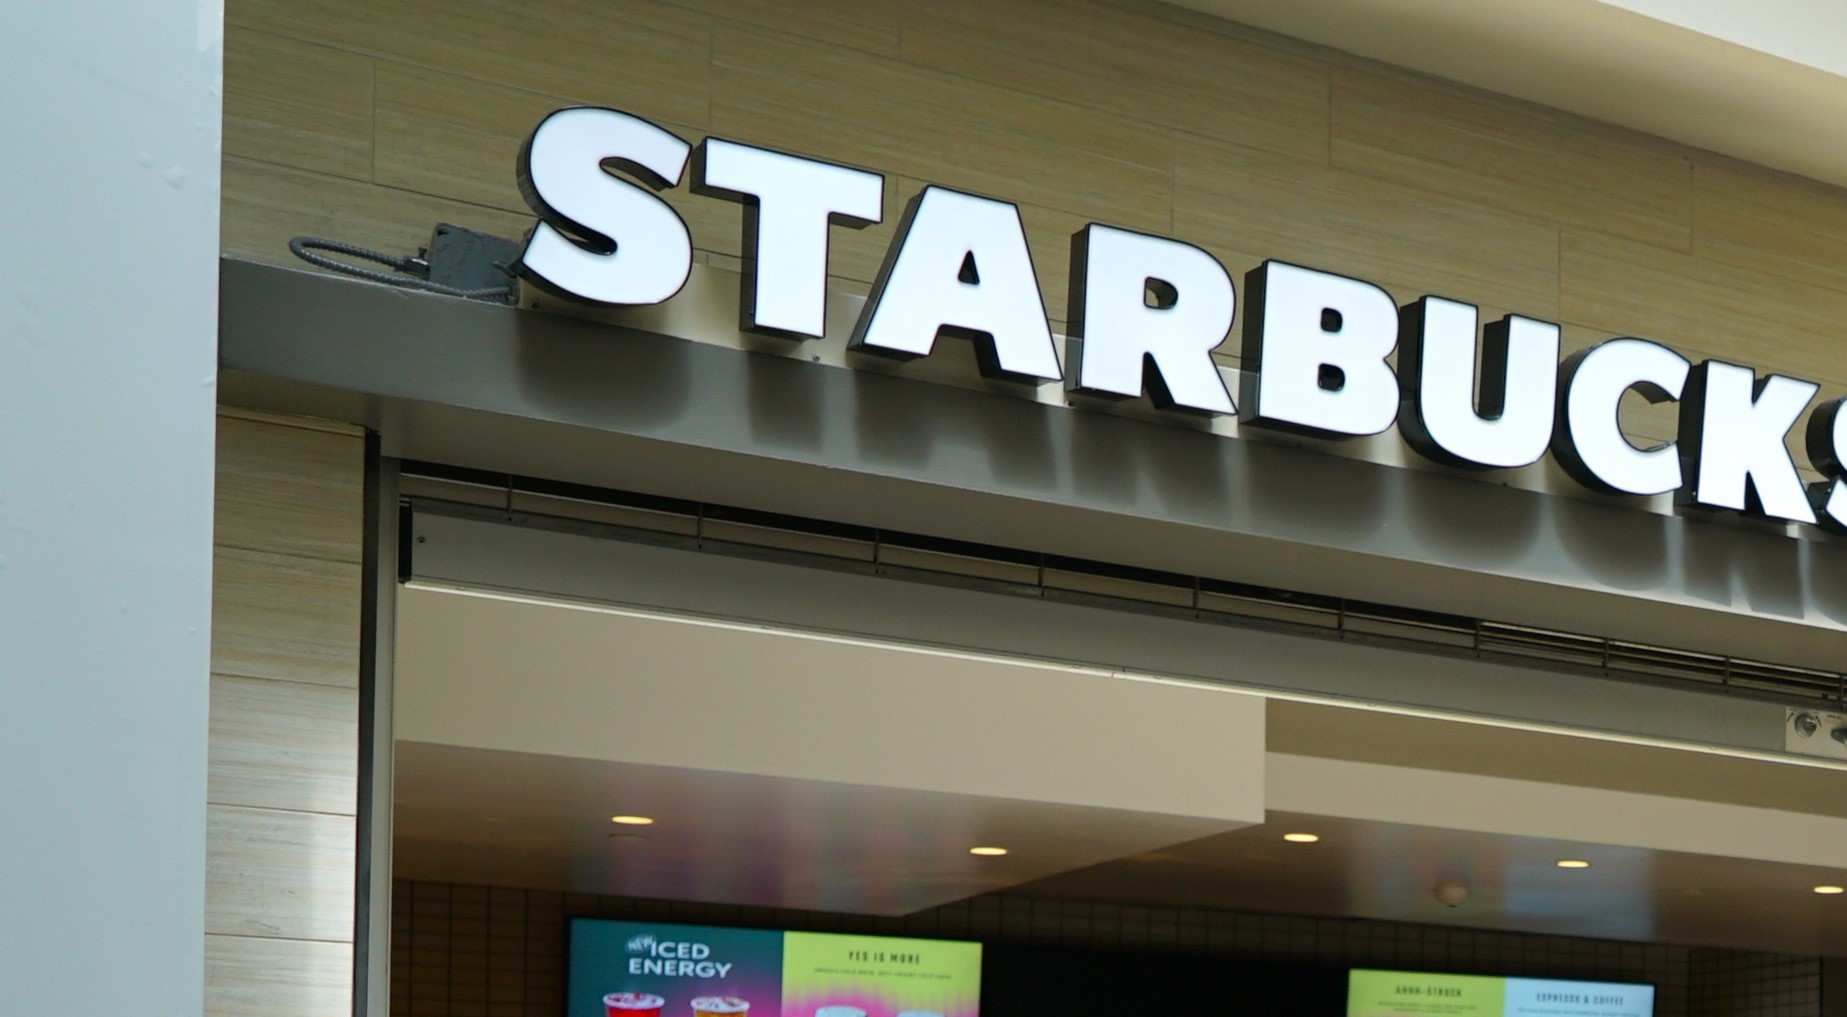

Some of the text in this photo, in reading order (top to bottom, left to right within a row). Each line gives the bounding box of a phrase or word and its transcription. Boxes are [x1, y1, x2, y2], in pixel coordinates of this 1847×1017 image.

[651, 941, 710, 960] ICED
[848, 951, 920, 965] YES IS MORE
[629, 957, 732, 979] ENERGY
